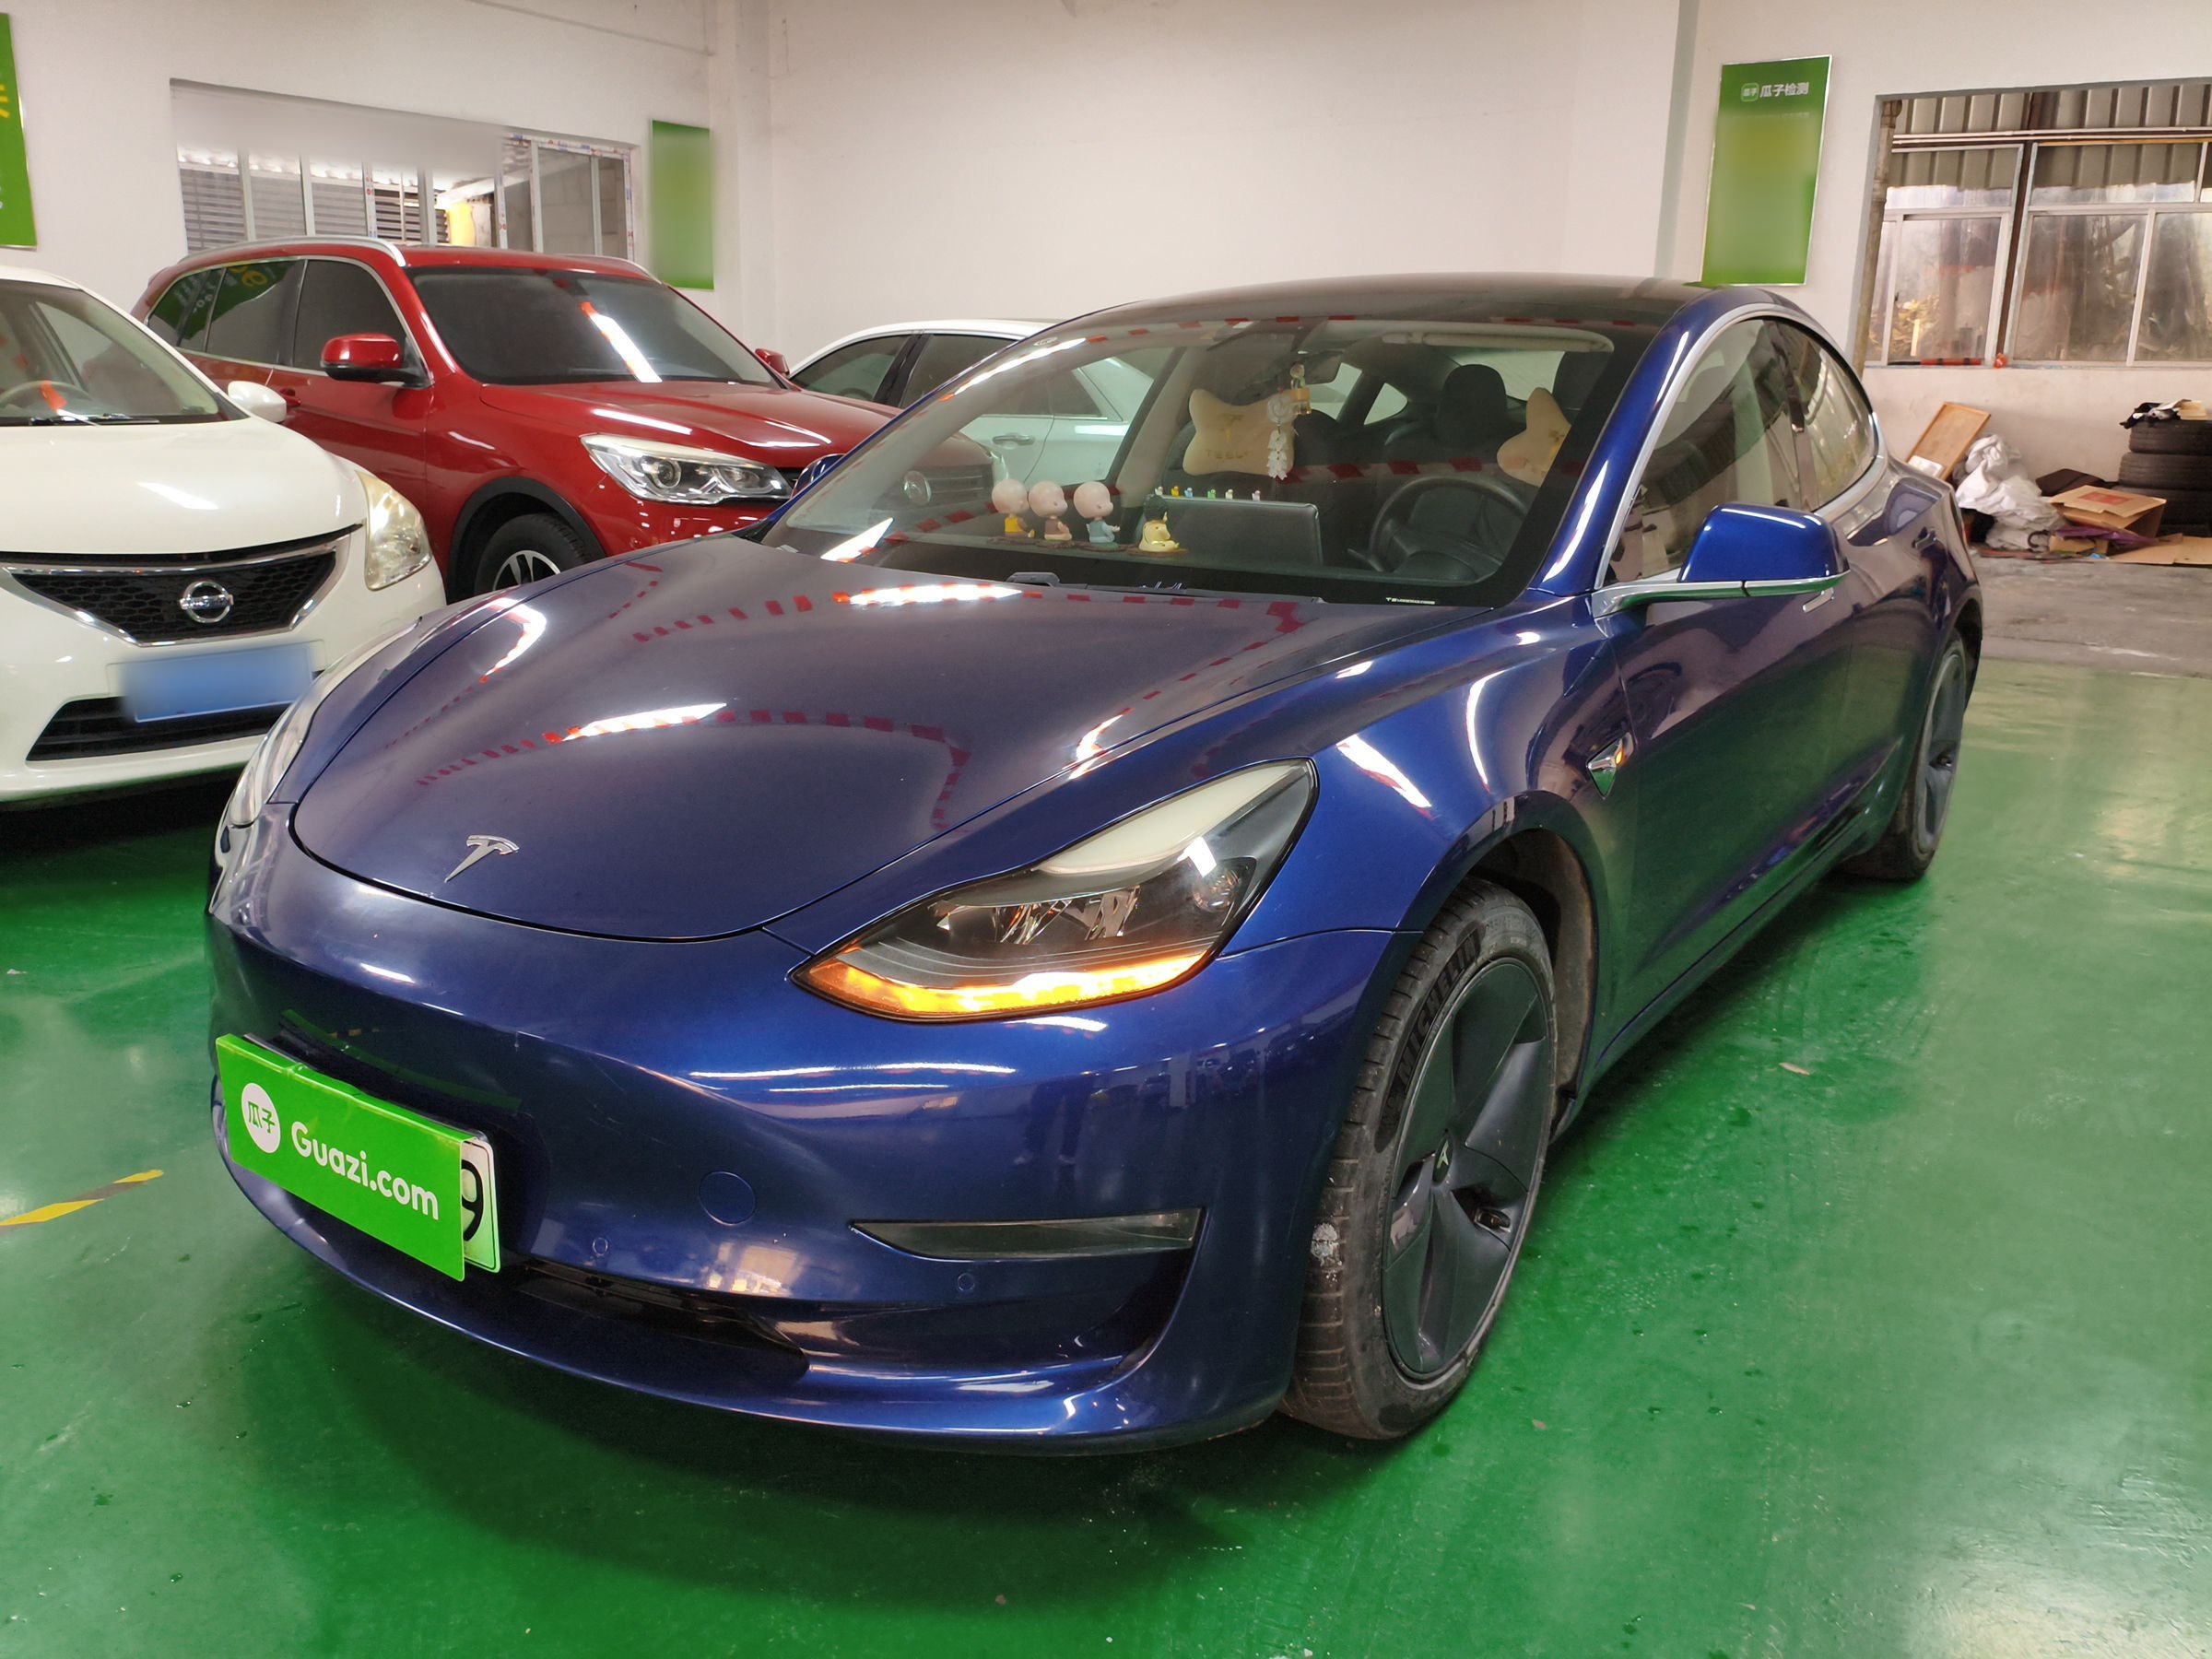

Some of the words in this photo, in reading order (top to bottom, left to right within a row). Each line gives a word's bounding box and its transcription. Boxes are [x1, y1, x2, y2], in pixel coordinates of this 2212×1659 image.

[1759, 82, 1810, 98] 瓜子检测
[1395, 933, 1479, 1087] MICHELIN
[248, 1101, 276, 1134] 瓜子
[291, 1122, 439, 1221] Guazi.com
